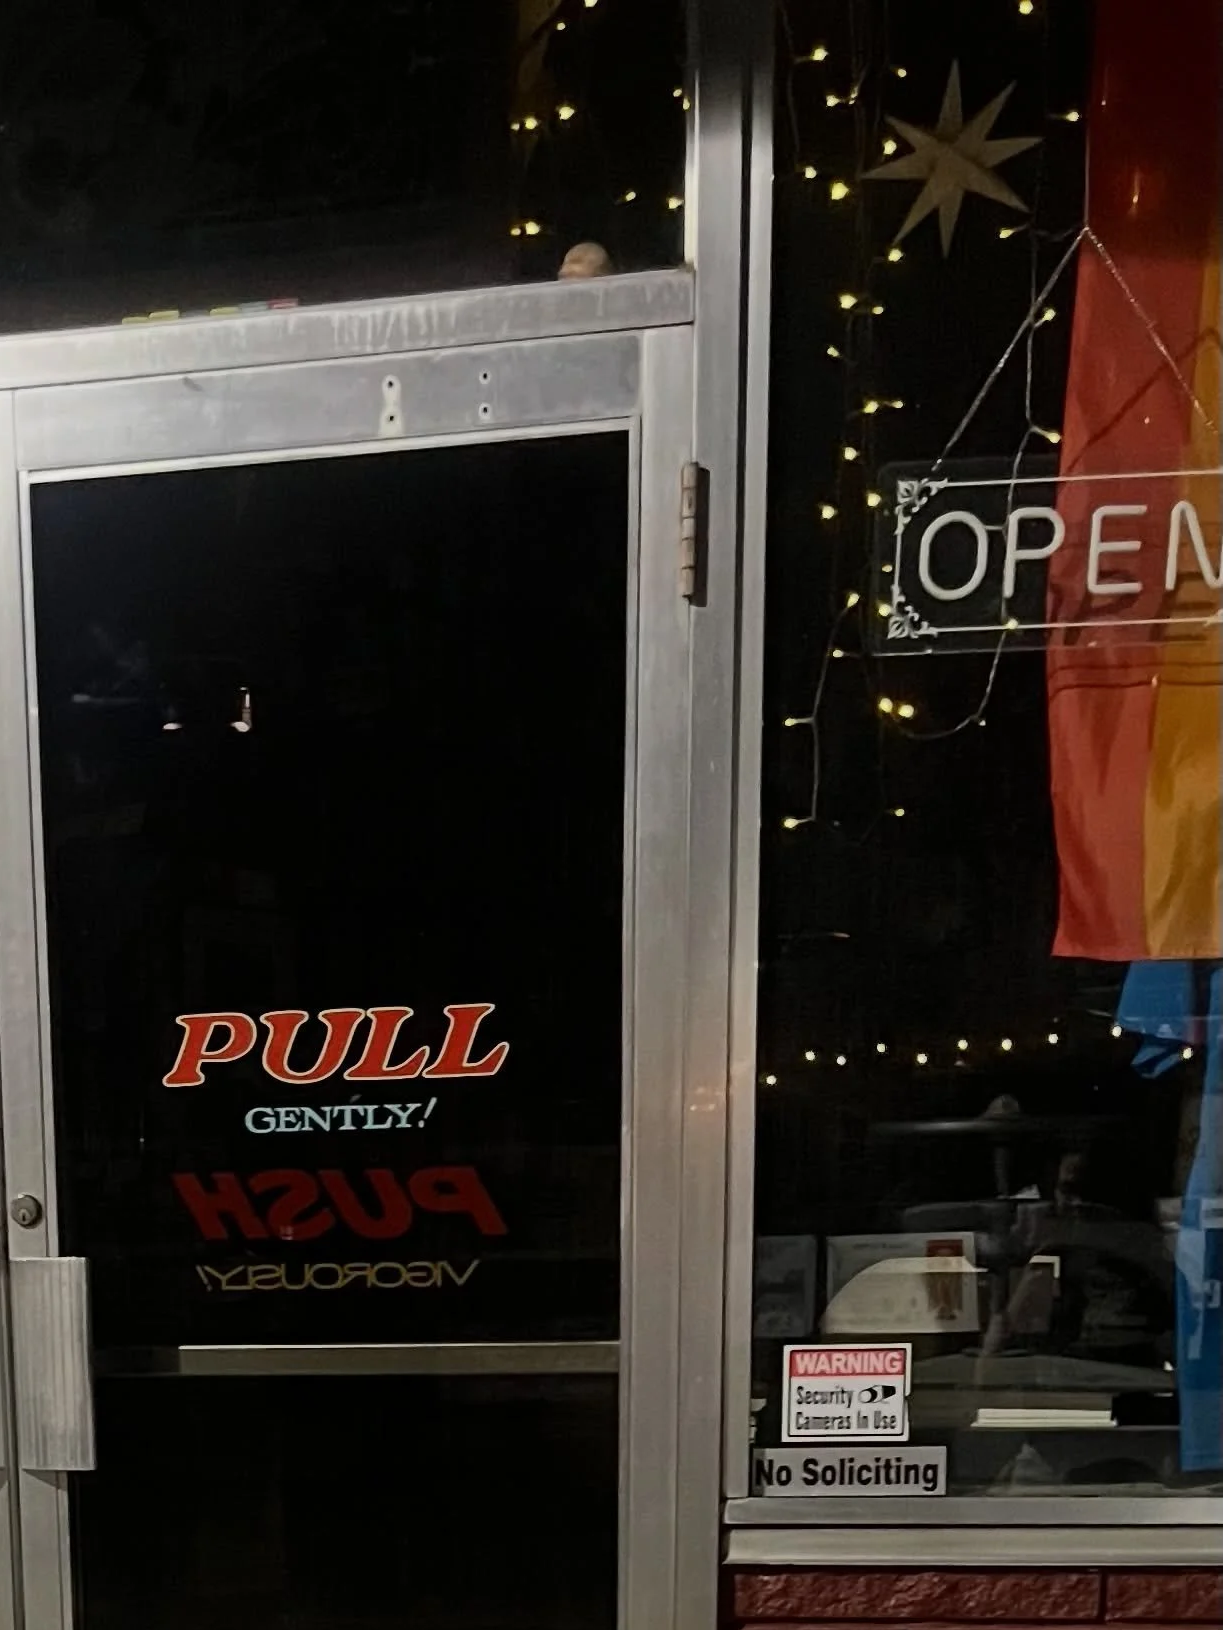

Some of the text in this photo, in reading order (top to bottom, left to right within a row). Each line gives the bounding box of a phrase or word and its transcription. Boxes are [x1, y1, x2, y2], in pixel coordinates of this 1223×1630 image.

[918, 500, 1223, 602] OPEN
[162, 1002, 510, 1088] PULL
[244, 1096, 438, 1134] GENTLY!
[795, 1351, 902, 1374] WARNING
[796, 1385, 853, 1408] Security
[796, 1410, 897, 1430] Cameras In Use
[755, 1456, 939, 1492] No Soliciting
